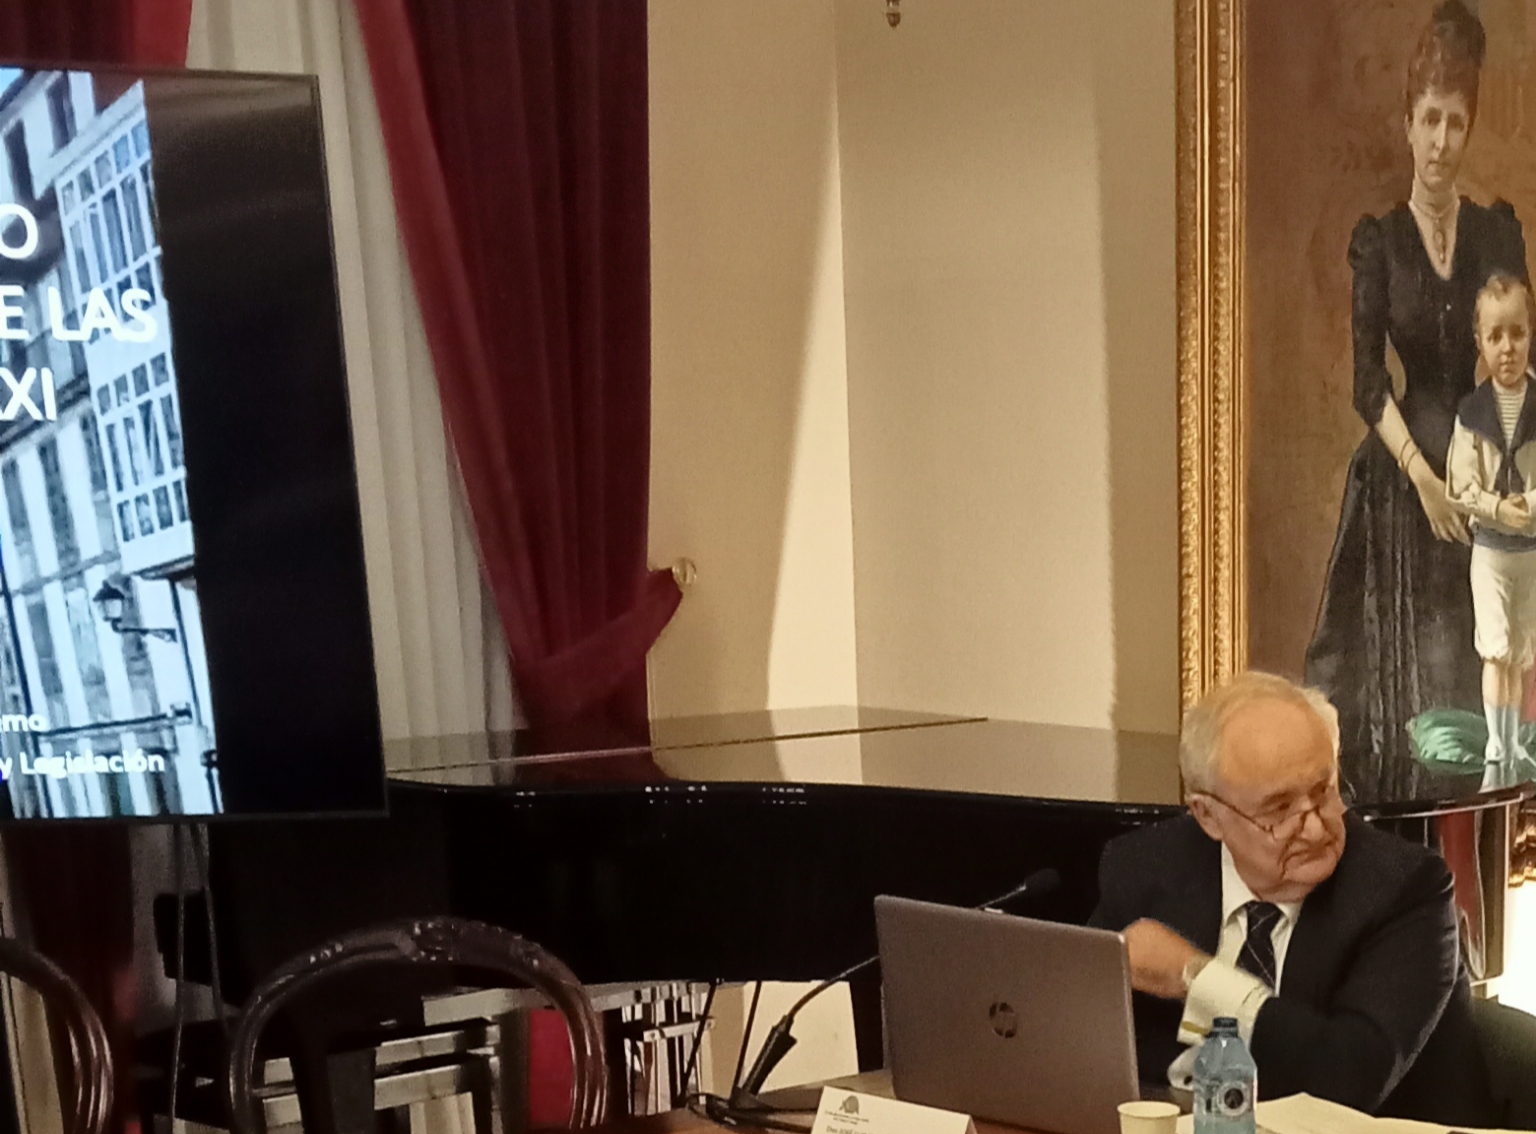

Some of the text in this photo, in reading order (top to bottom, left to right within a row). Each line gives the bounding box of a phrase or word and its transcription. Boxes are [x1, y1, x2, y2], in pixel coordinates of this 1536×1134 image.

[47, 286, 157, 343] LAS
[0, 367, 57, 421] XI
[0, 713, 47, 732] mo
[20, 748, 165, 779] Legislación
